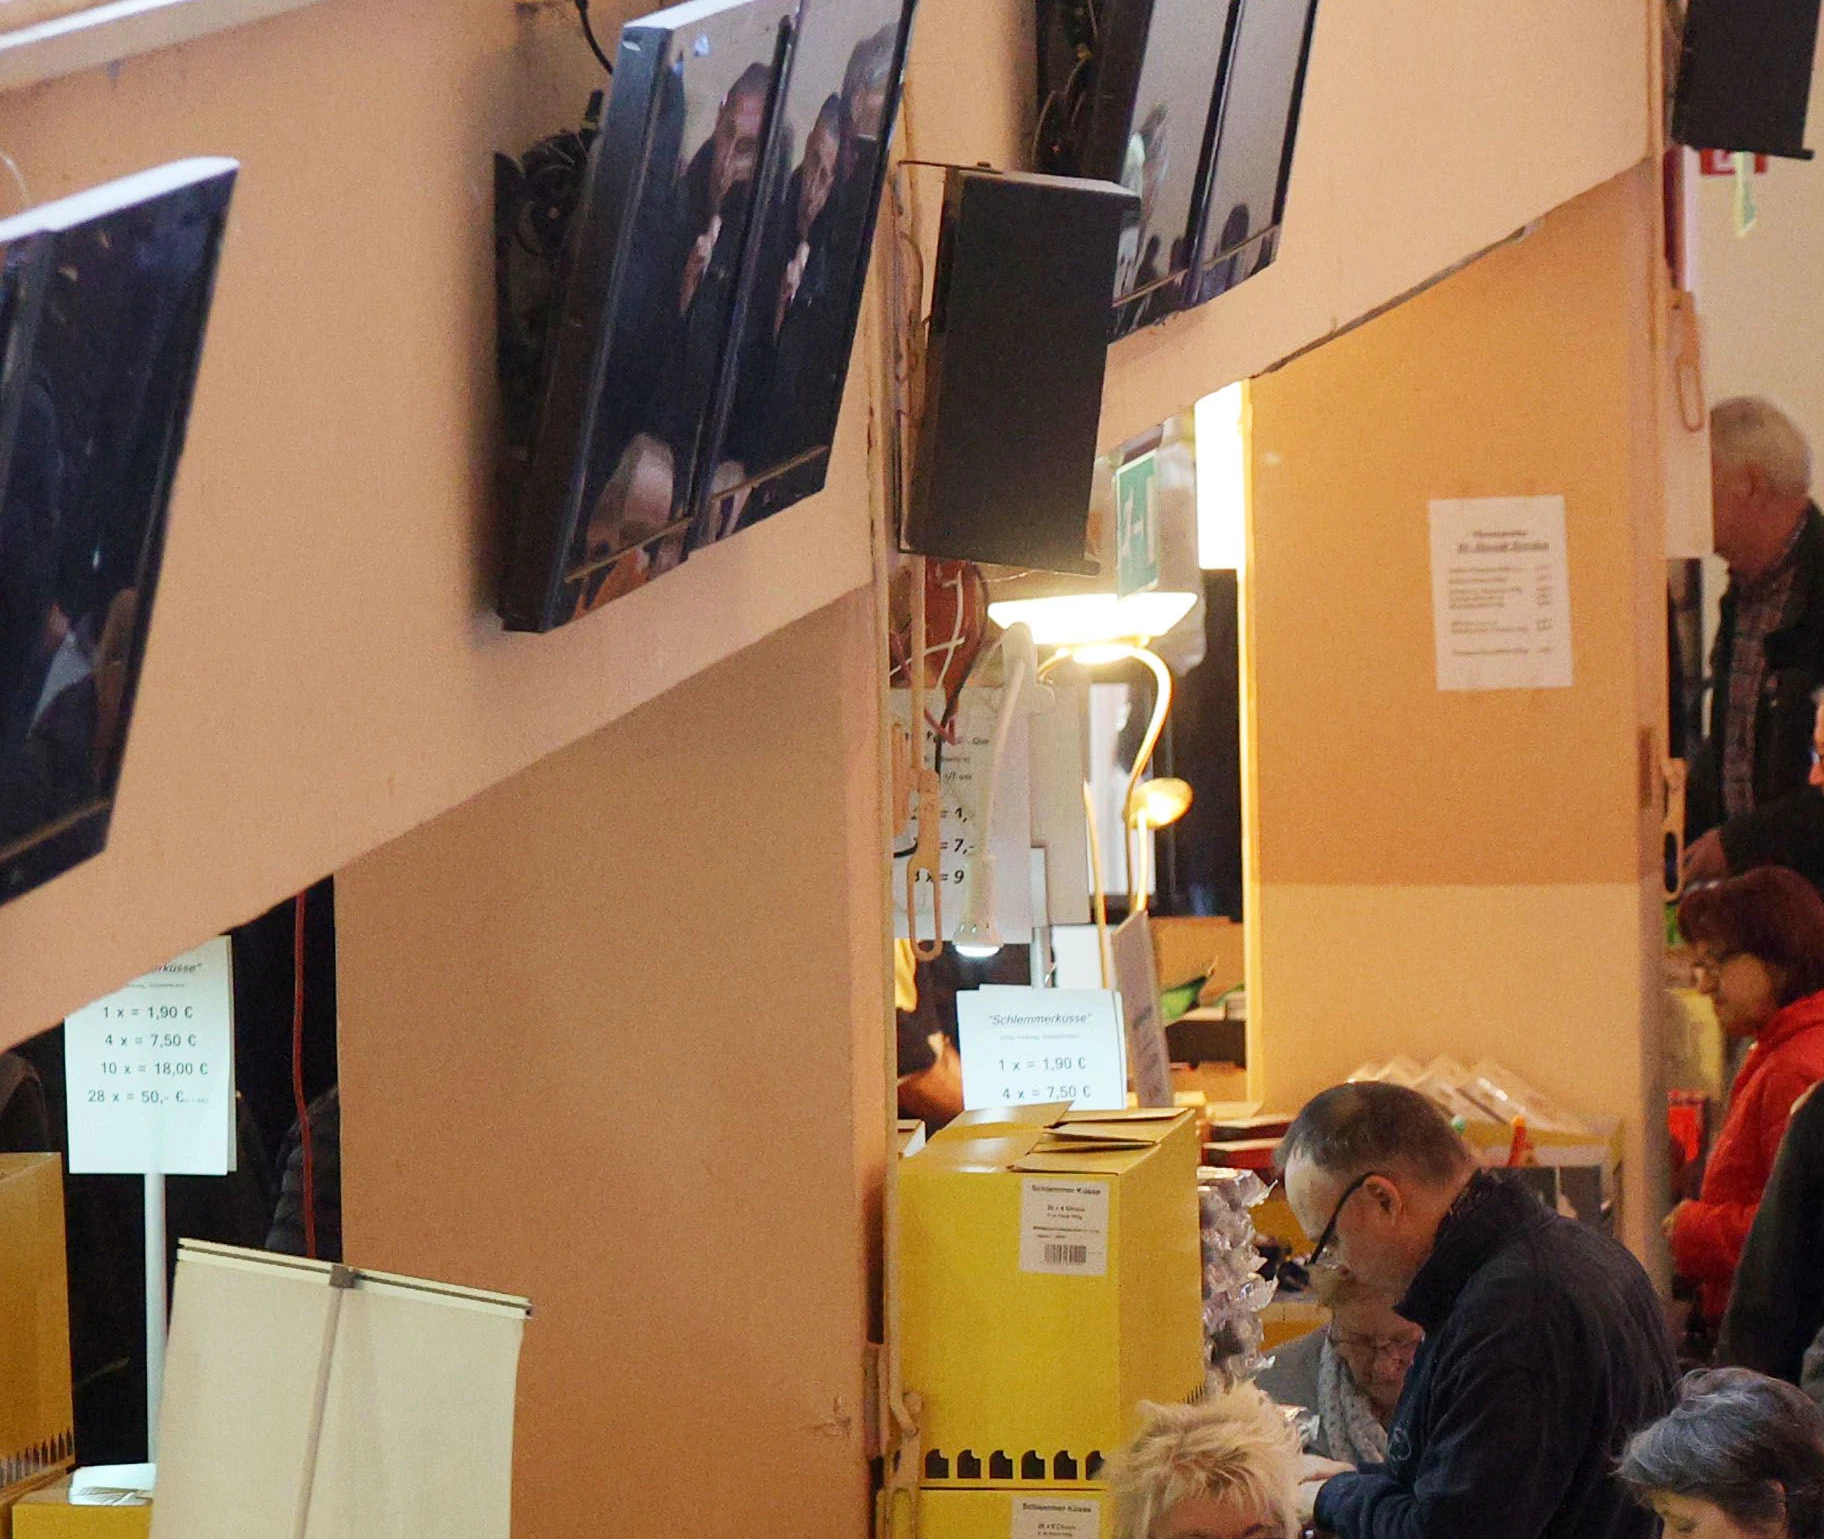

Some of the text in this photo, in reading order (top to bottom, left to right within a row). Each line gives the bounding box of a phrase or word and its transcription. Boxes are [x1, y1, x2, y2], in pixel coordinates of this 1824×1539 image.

[104, 1007, 109, 1018] 1
[116, 1009, 124, 1017] x
[147, 1006, 178, 1020] 1,90
[184, 1006, 194, 1018] €
[105, 1034, 113, 1045] 4
[120, 1036, 128, 1045] x
[150, 1034, 181, 1048] 7,50
[188, 1034, 197, 1046] €
[101, 1062, 117, 1074] 10
[124, 1066, 132, 1075] x
[155, 1062, 193, 1076] 18,00
[199, 1062, 208, 1075] €
[998, 1059, 1005, 1071] 1
[1012, 1062, 1020, 1071] x
[1043, 1057, 1072, 1071] 1,90
[1078, 1057, 1086, 1069] €
[88, 1090, 105, 1102] 28
[112, 1093, 120, 1102] x
[175, 1090, 184, 1103] €
[1002, 1088, 1010, 1099] 4
[1017, 1090, 1025, 1099] x
[1047, 1086, 1077, 1099] 7,50
[1083, 1085, 1091, 1098] €
